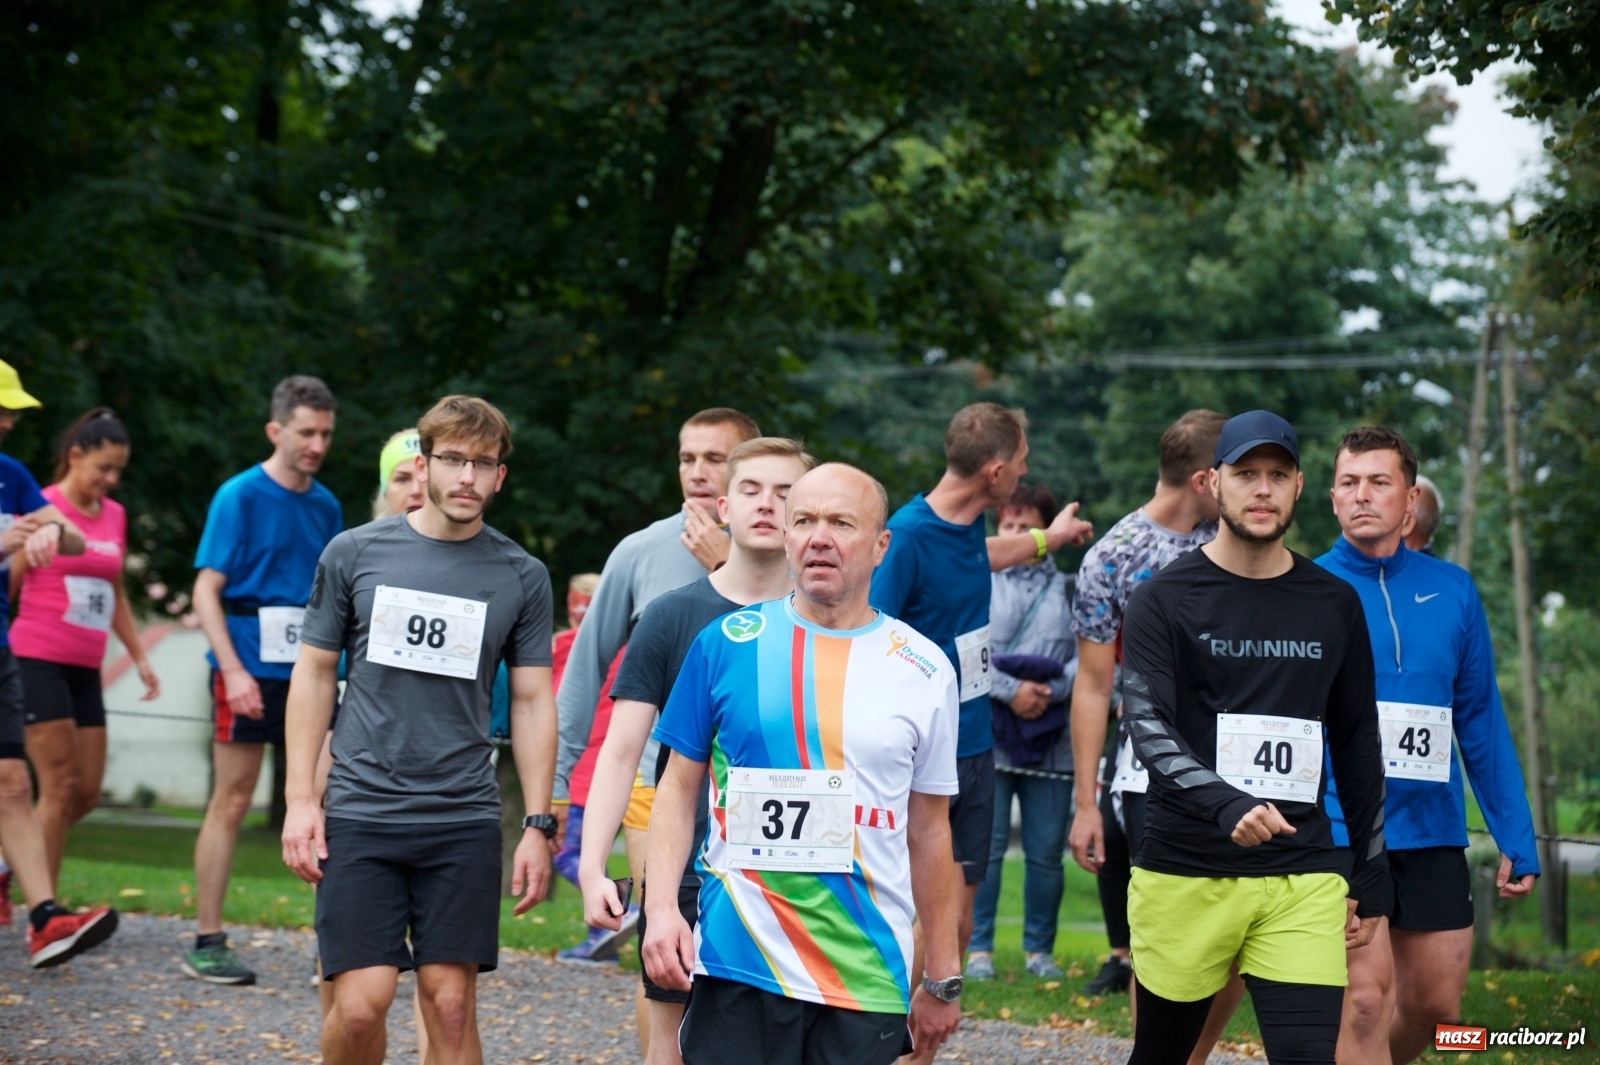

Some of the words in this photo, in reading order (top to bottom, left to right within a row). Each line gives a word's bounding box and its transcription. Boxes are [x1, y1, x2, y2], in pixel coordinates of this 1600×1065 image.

[406, 614, 447, 649] 98
[902, 645, 938, 673] Dystans
[1210, 639, 1323, 660] RUNNING
[1253, 740, 1293, 775] 40
[1398, 726, 1431, 758] 43
[772, 780, 803, 789] 19.09.2021
[761, 799, 811, 841] 37
